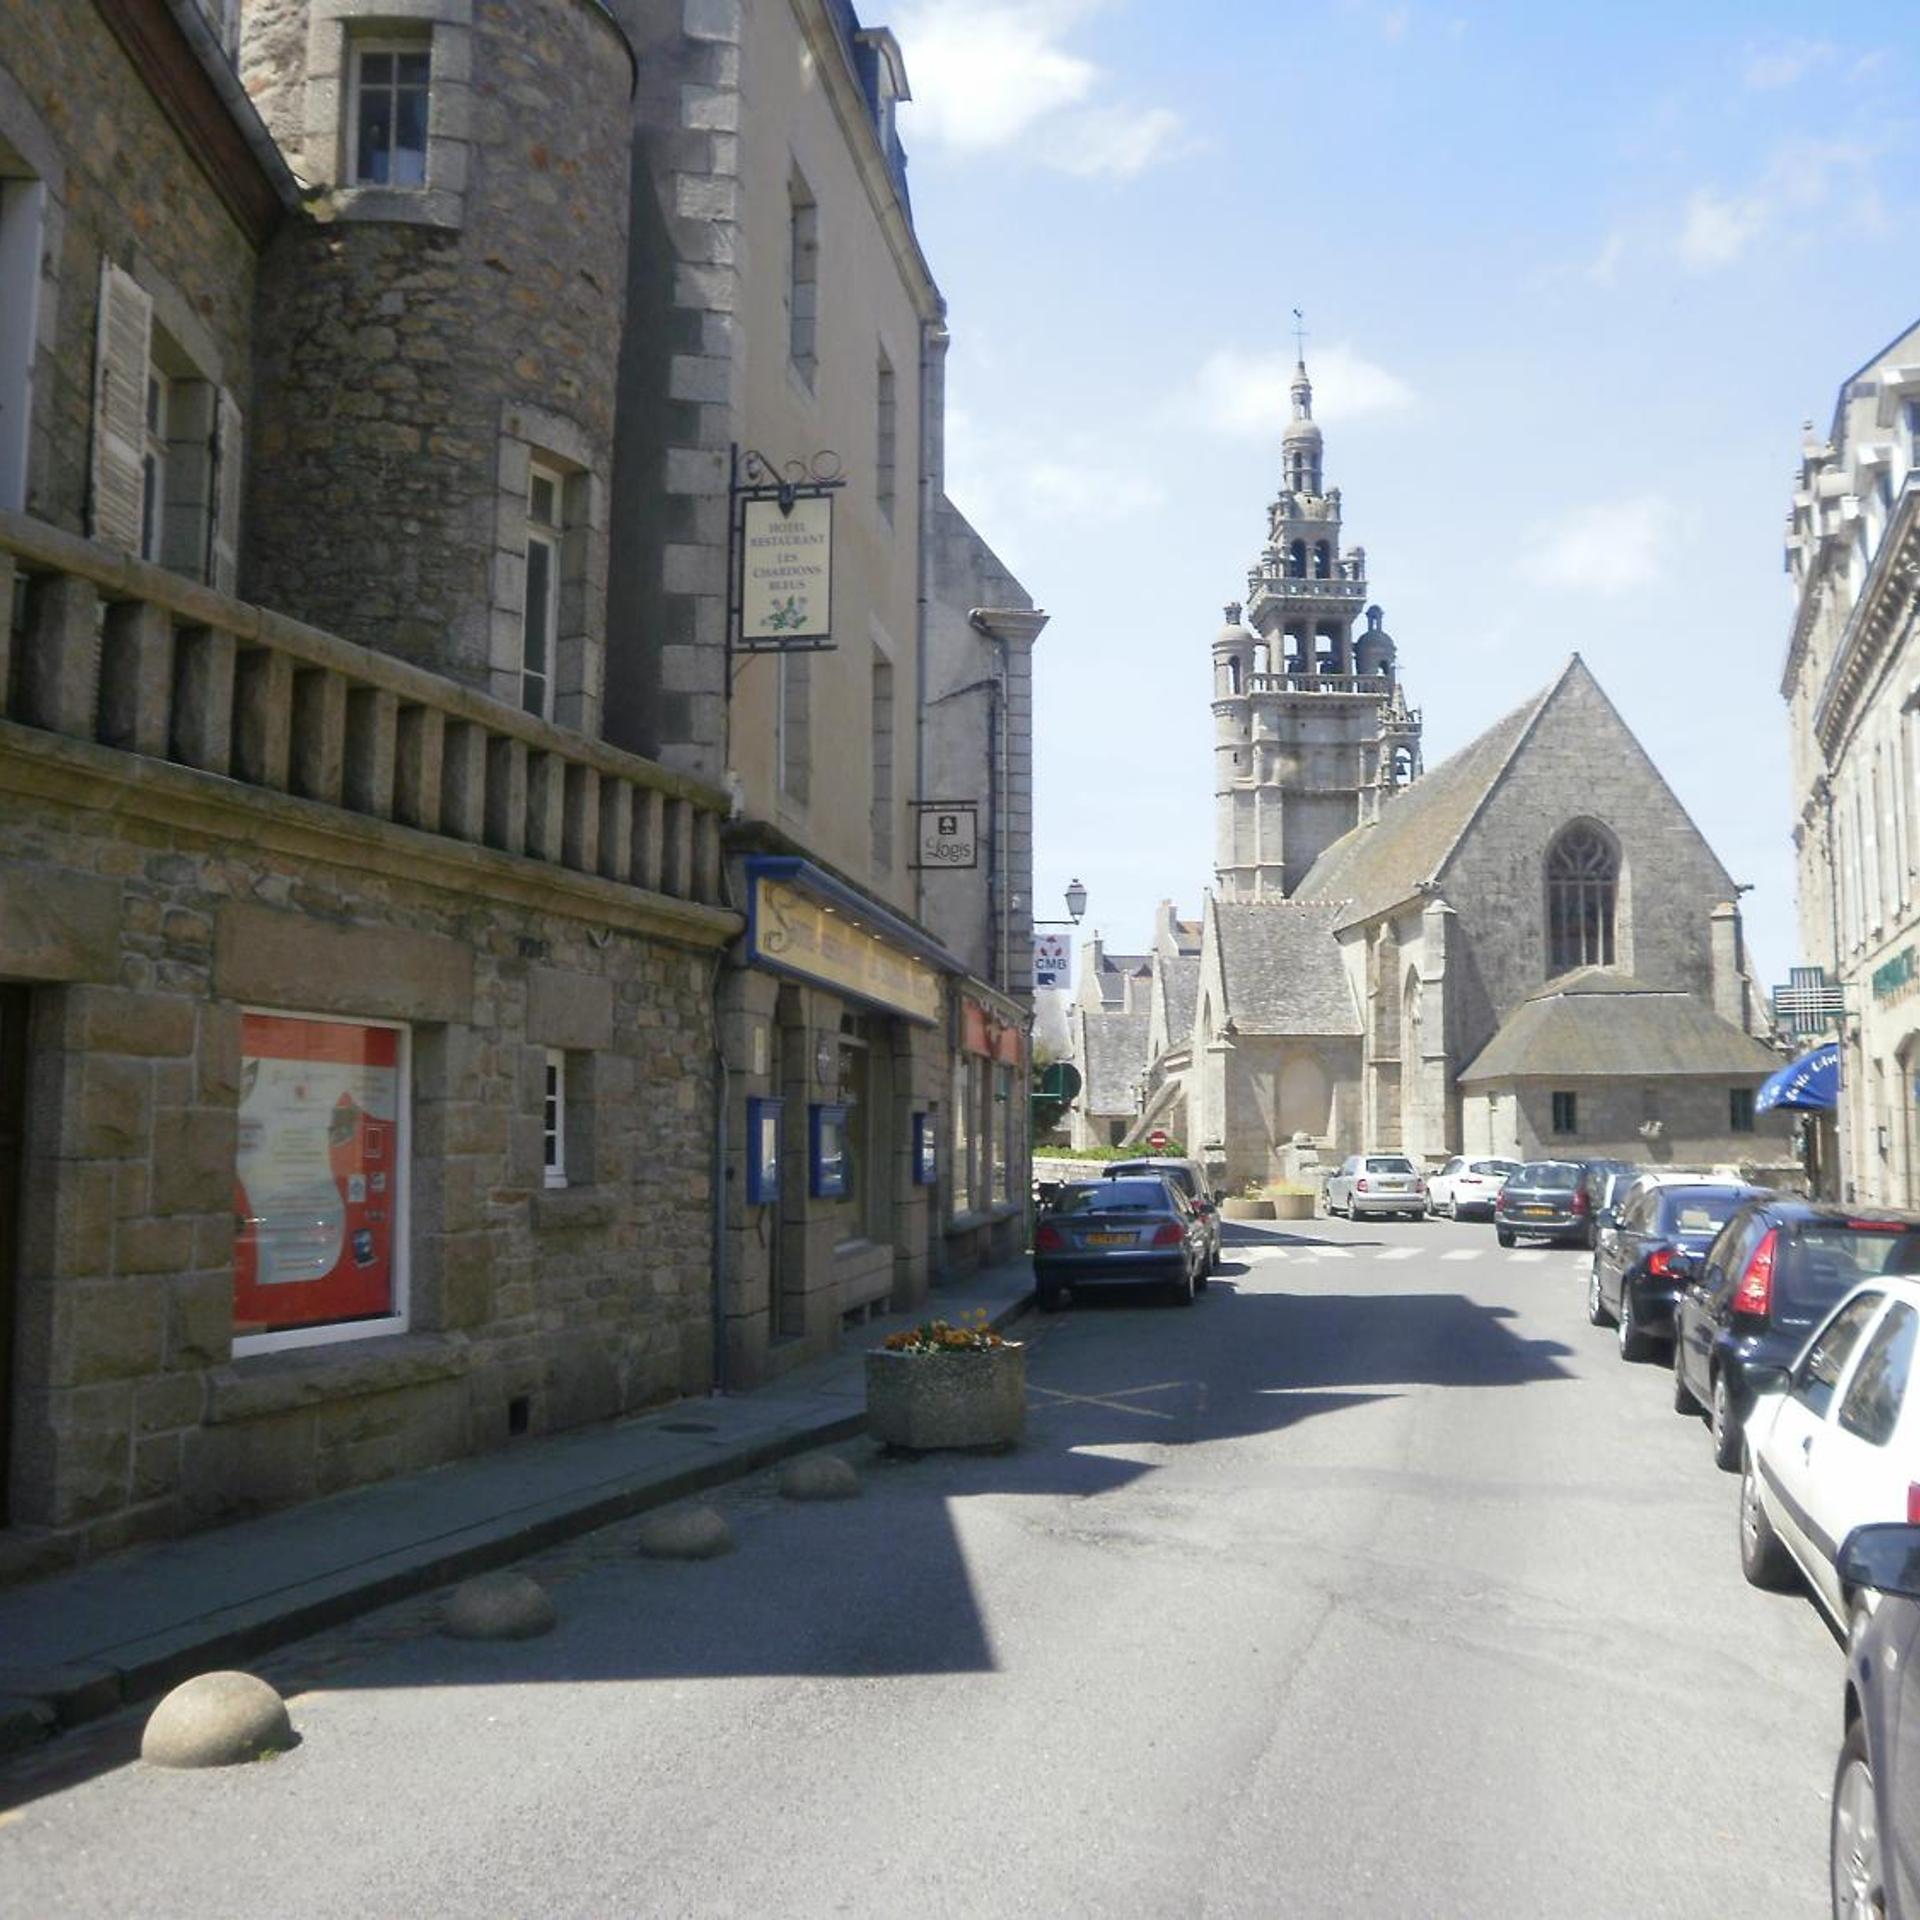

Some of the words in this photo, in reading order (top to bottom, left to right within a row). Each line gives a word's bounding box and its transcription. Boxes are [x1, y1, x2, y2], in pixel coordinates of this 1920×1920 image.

[751, 534, 824, 546] RESTAURANT
[777, 553, 798, 563] LES
[754, 565, 821, 578] CHARDONS
[769, 580, 806, 591] BLEUS
[1035, 958, 1067, 970] CMB
